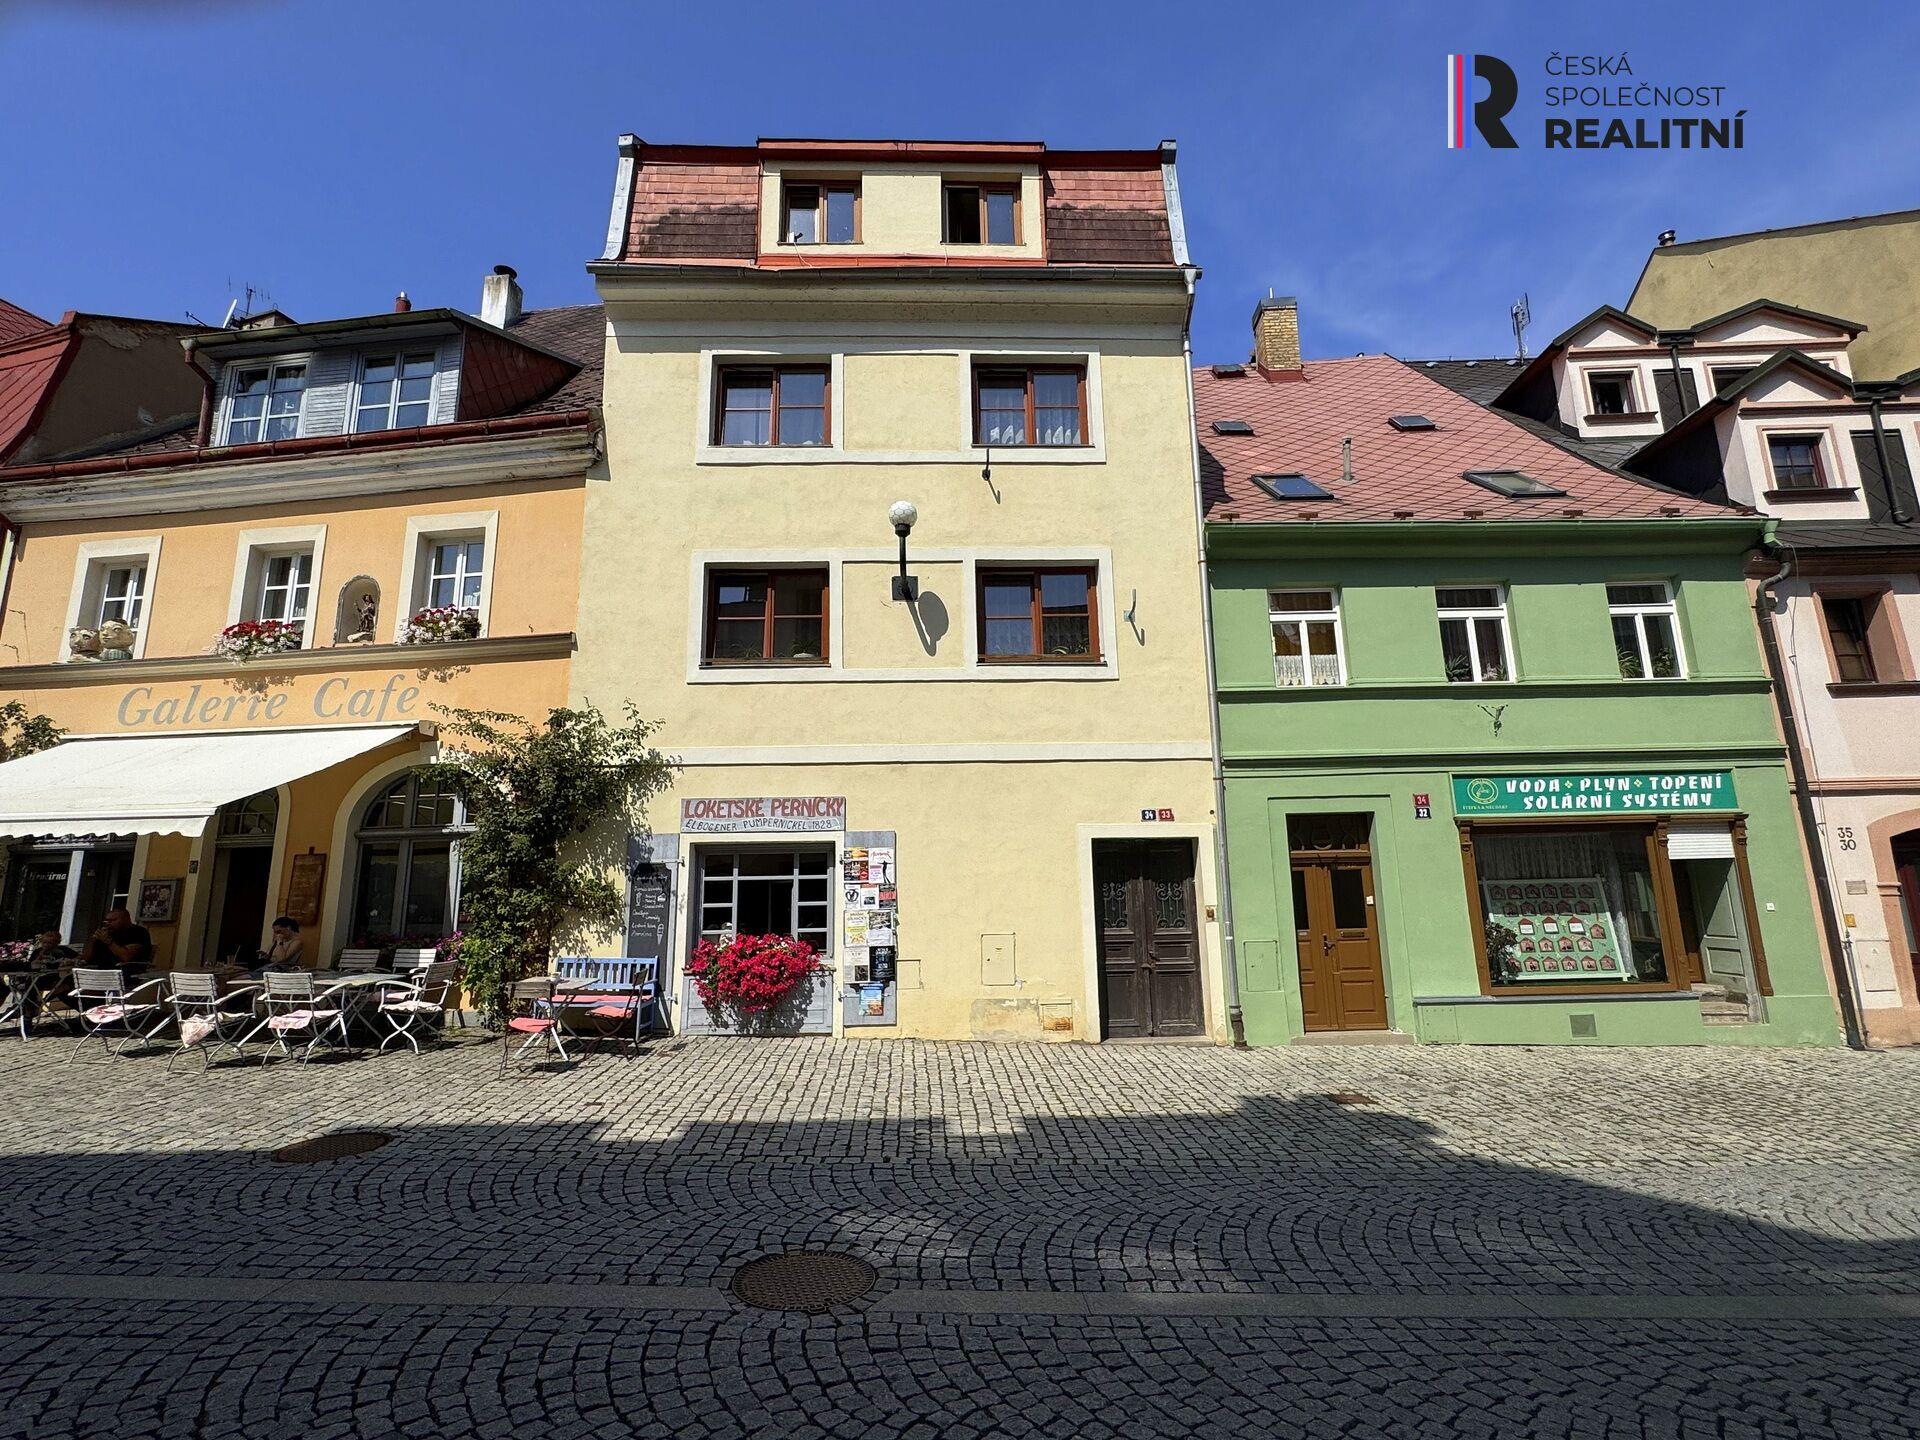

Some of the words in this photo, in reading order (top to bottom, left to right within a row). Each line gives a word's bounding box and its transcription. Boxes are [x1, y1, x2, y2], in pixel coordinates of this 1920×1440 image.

[117, 684, 288, 727] Galerie
[313, 673, 419, 723] Cafe
[1506, 779, 1560, 793] VODA
[1580, 777, 1630, 791] PLYN
[1649, 773, 1722, 790] TOPENÍ
[1416, 796, 1427, 805] 34
[1523, 792, 1611, 810] SOLÁRNÍ
[1622, 790, 1711, 807] SYSTÉMY
[684, 797, 765, 819] LOKETSKÉ
[1419, 808, 1428, 818] 32
[1144, 810, 1154, 820] 34
[1161, 810, 1171, 819] 33
[685, 819, 738, 832] ELBOGENER
[743, 817, 807, 829] PUMPERNICKEL
[811, 819, 832, 830] 1828
[1837, 827, 1853, 839] 35
[1840, 839, 1857, 851] 30
